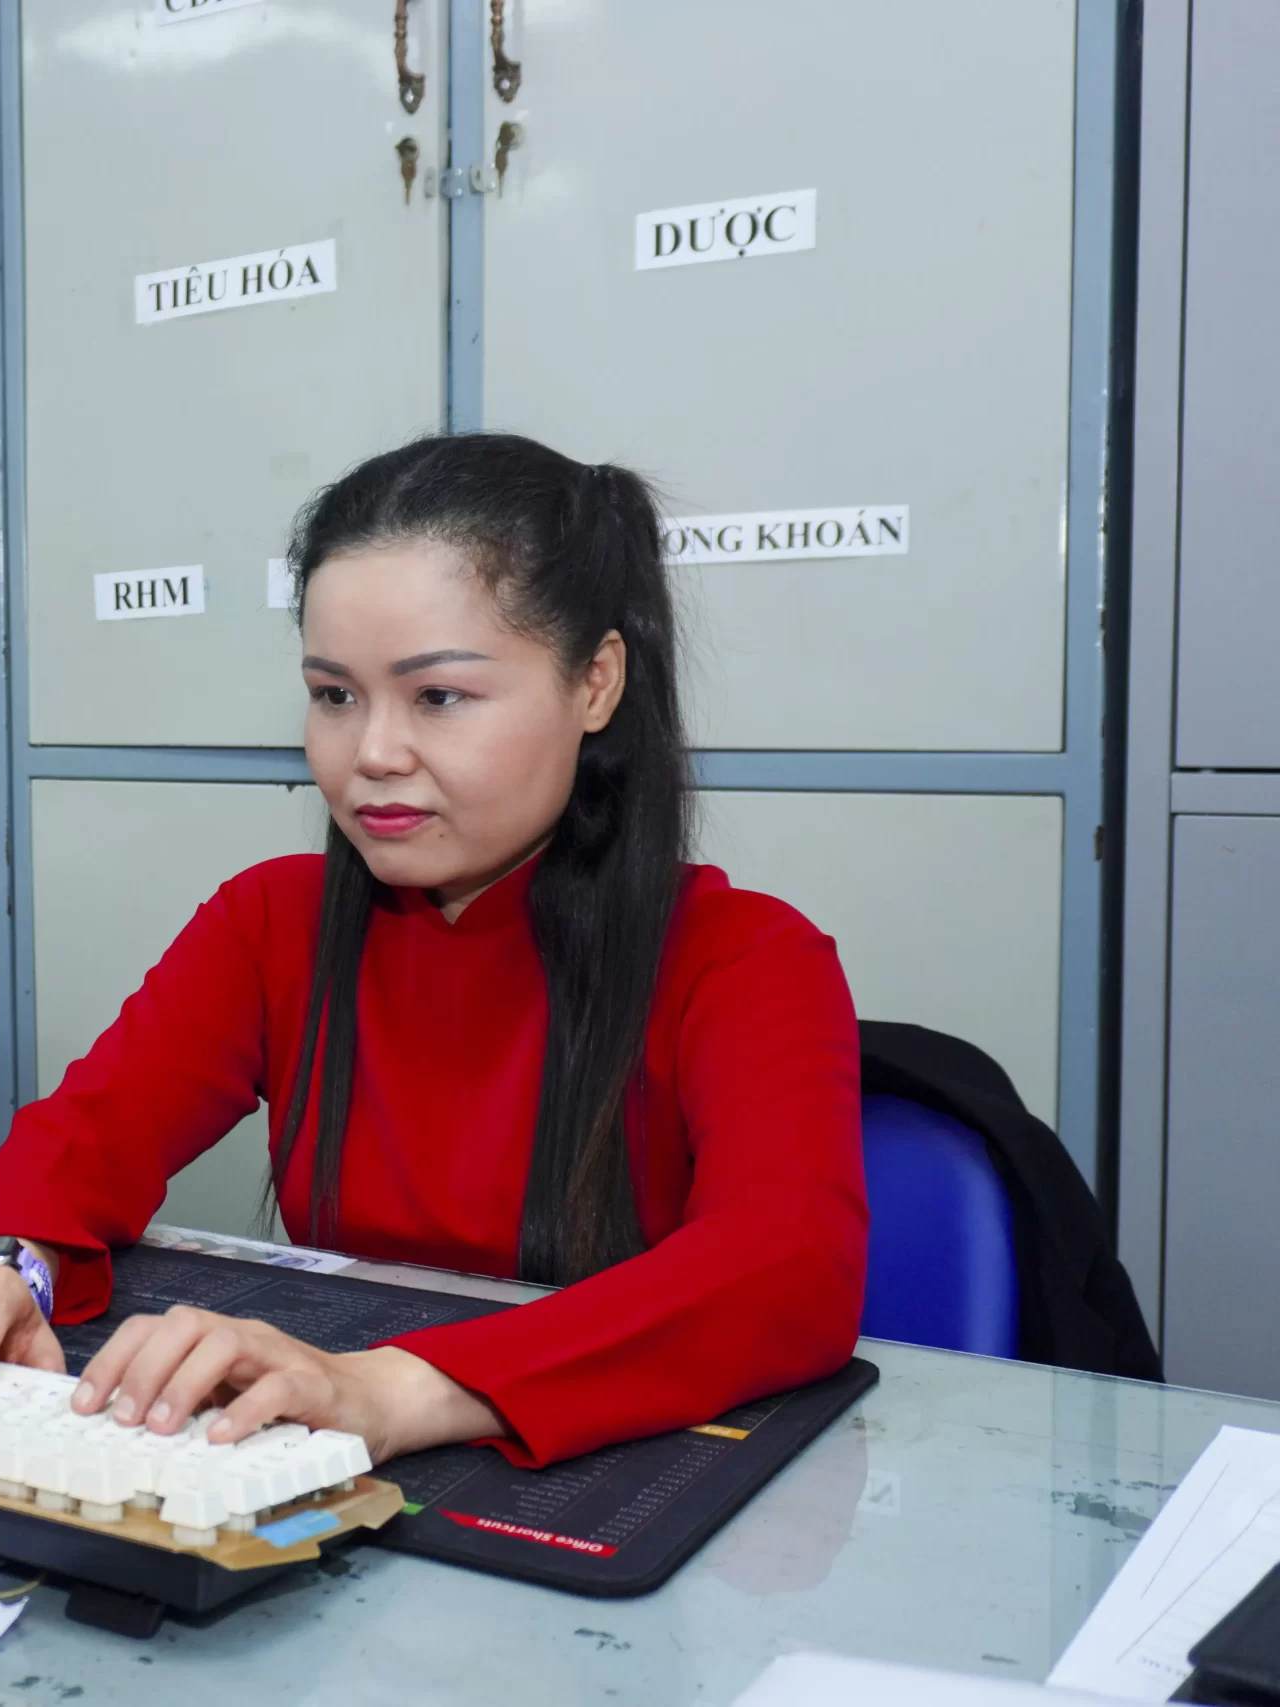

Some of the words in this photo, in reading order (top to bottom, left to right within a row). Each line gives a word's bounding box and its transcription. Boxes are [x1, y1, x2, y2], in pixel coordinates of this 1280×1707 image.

[652, 205, 797, 258] DƯỢC
[148, 265, 228, 312] TIÊU
[240, 249, 321, 296] HÓA
[662, 526, 743, 556] ƠNG
[756, 510, 903, 551] KHOÁN
[113, 576, 190, 611] RHM
[476, 1517, 554, 1542] Shortcuts
[556, 1535, 604, 1552] Office
